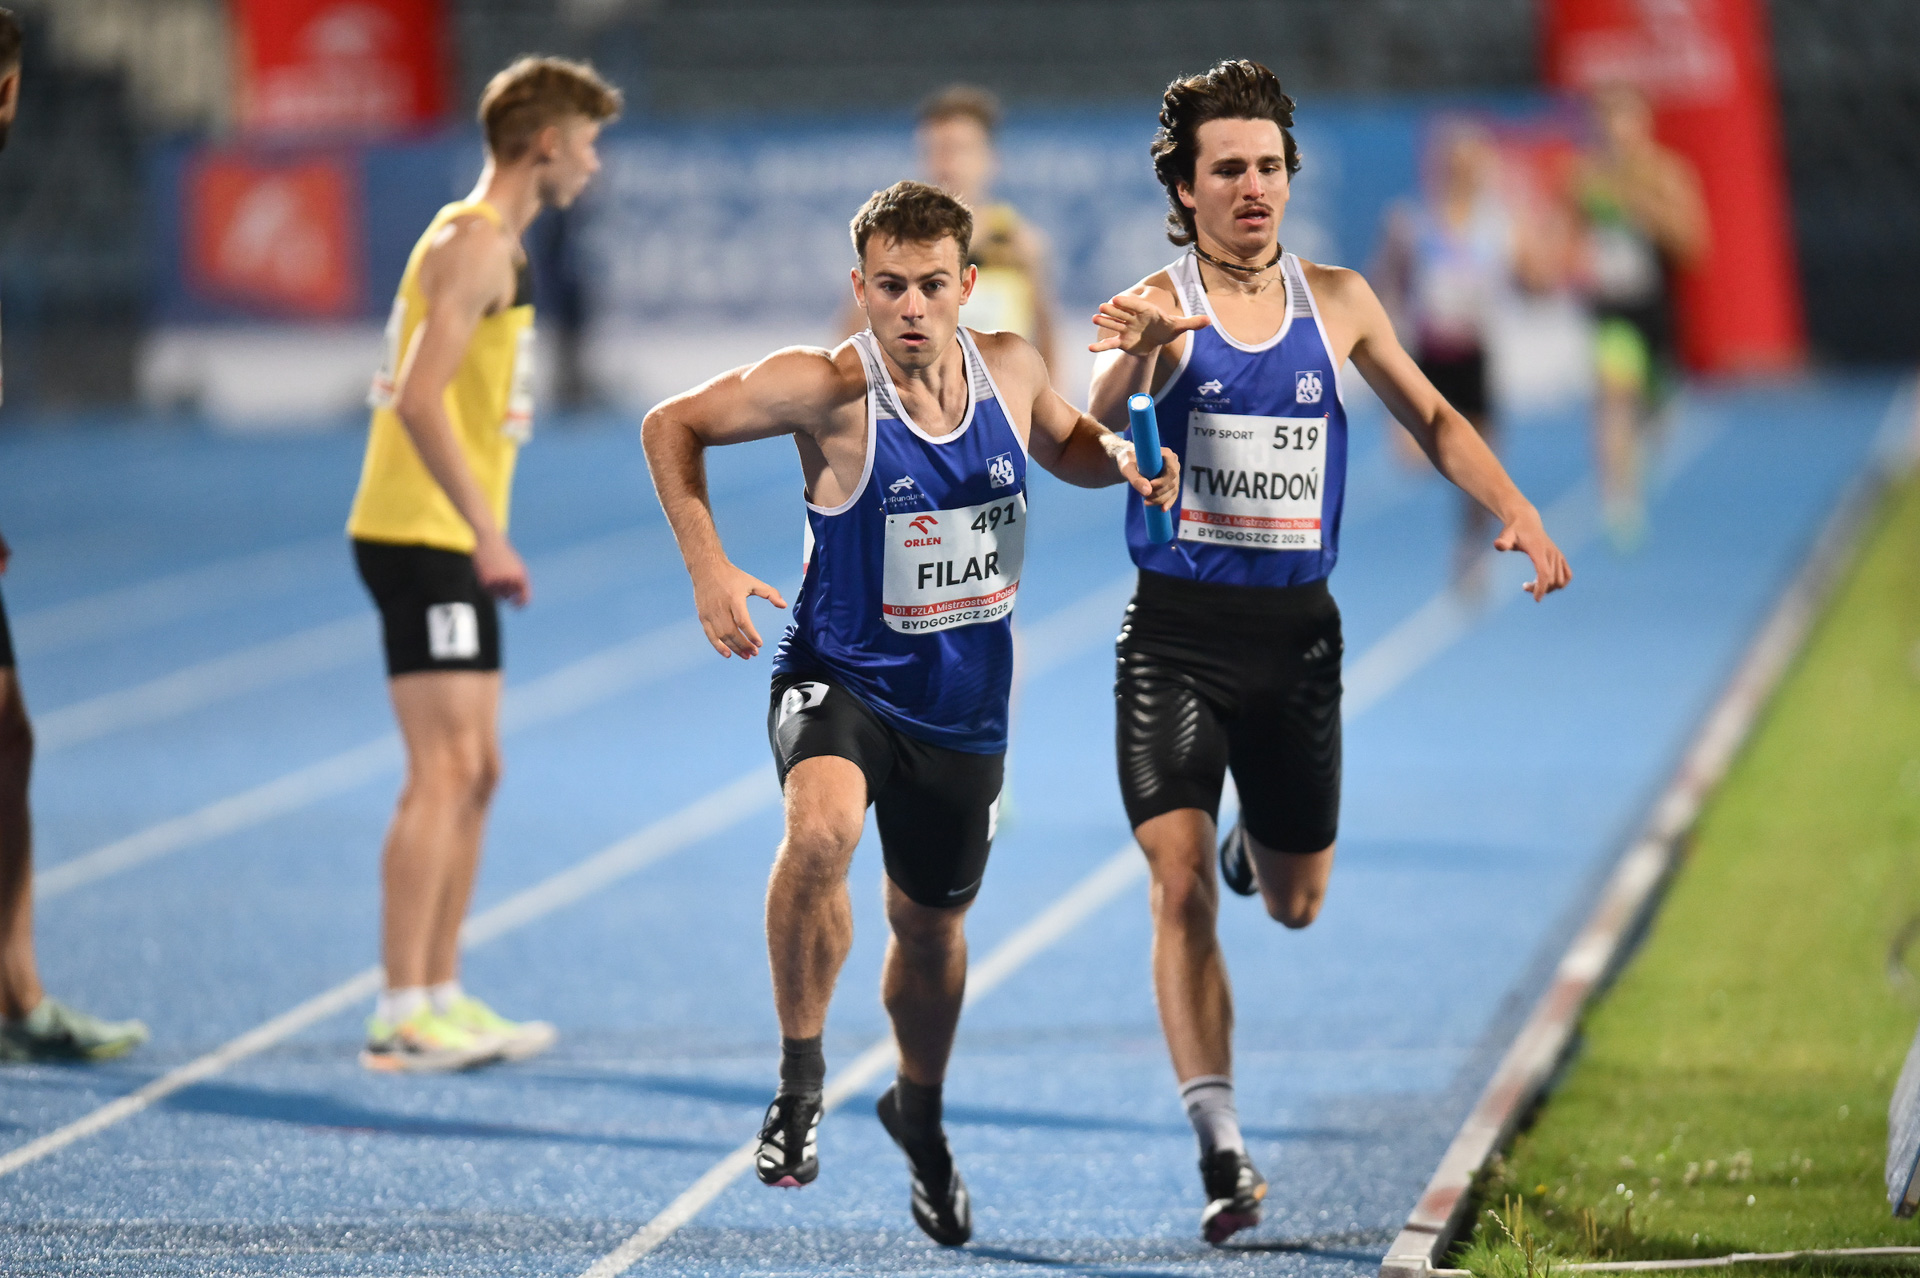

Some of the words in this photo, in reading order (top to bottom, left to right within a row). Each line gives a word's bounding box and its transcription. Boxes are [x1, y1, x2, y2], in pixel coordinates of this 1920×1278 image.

[1193, 426, 1216, 437] TVP
[1218, 430, 1254, 439] SPORT
[1272, 425, 1319, 450] 519
[1190, 466, 1318, 501] TWARDOŃ
[970, 502, 1016, 534] 491
[1189, 511, 1205, 521] 101.
[1207, 515, 1231, 525] PZLA
[1233, 517, 1292, 529] Mistrzostwa
[1293, 520, 1315, 529] Polski
[904, 537, 941, 548] ORLEN
[1197, 527, 1278, 544] BYDGOSZCZ
[1281, 534, 1306, 544] 2025
[918, 551, 999, 590] FILAR
[891, 606, 907, 615] 101.
[911, 605, 935, 616] PZLA
[936, 594, 995, 613] Mistrzostwa
[995, 584, 1018, 600] Polski
[901, 609, 980, 630] BYDGOSZCZ
[983, 601, 1009, 619] 2025
